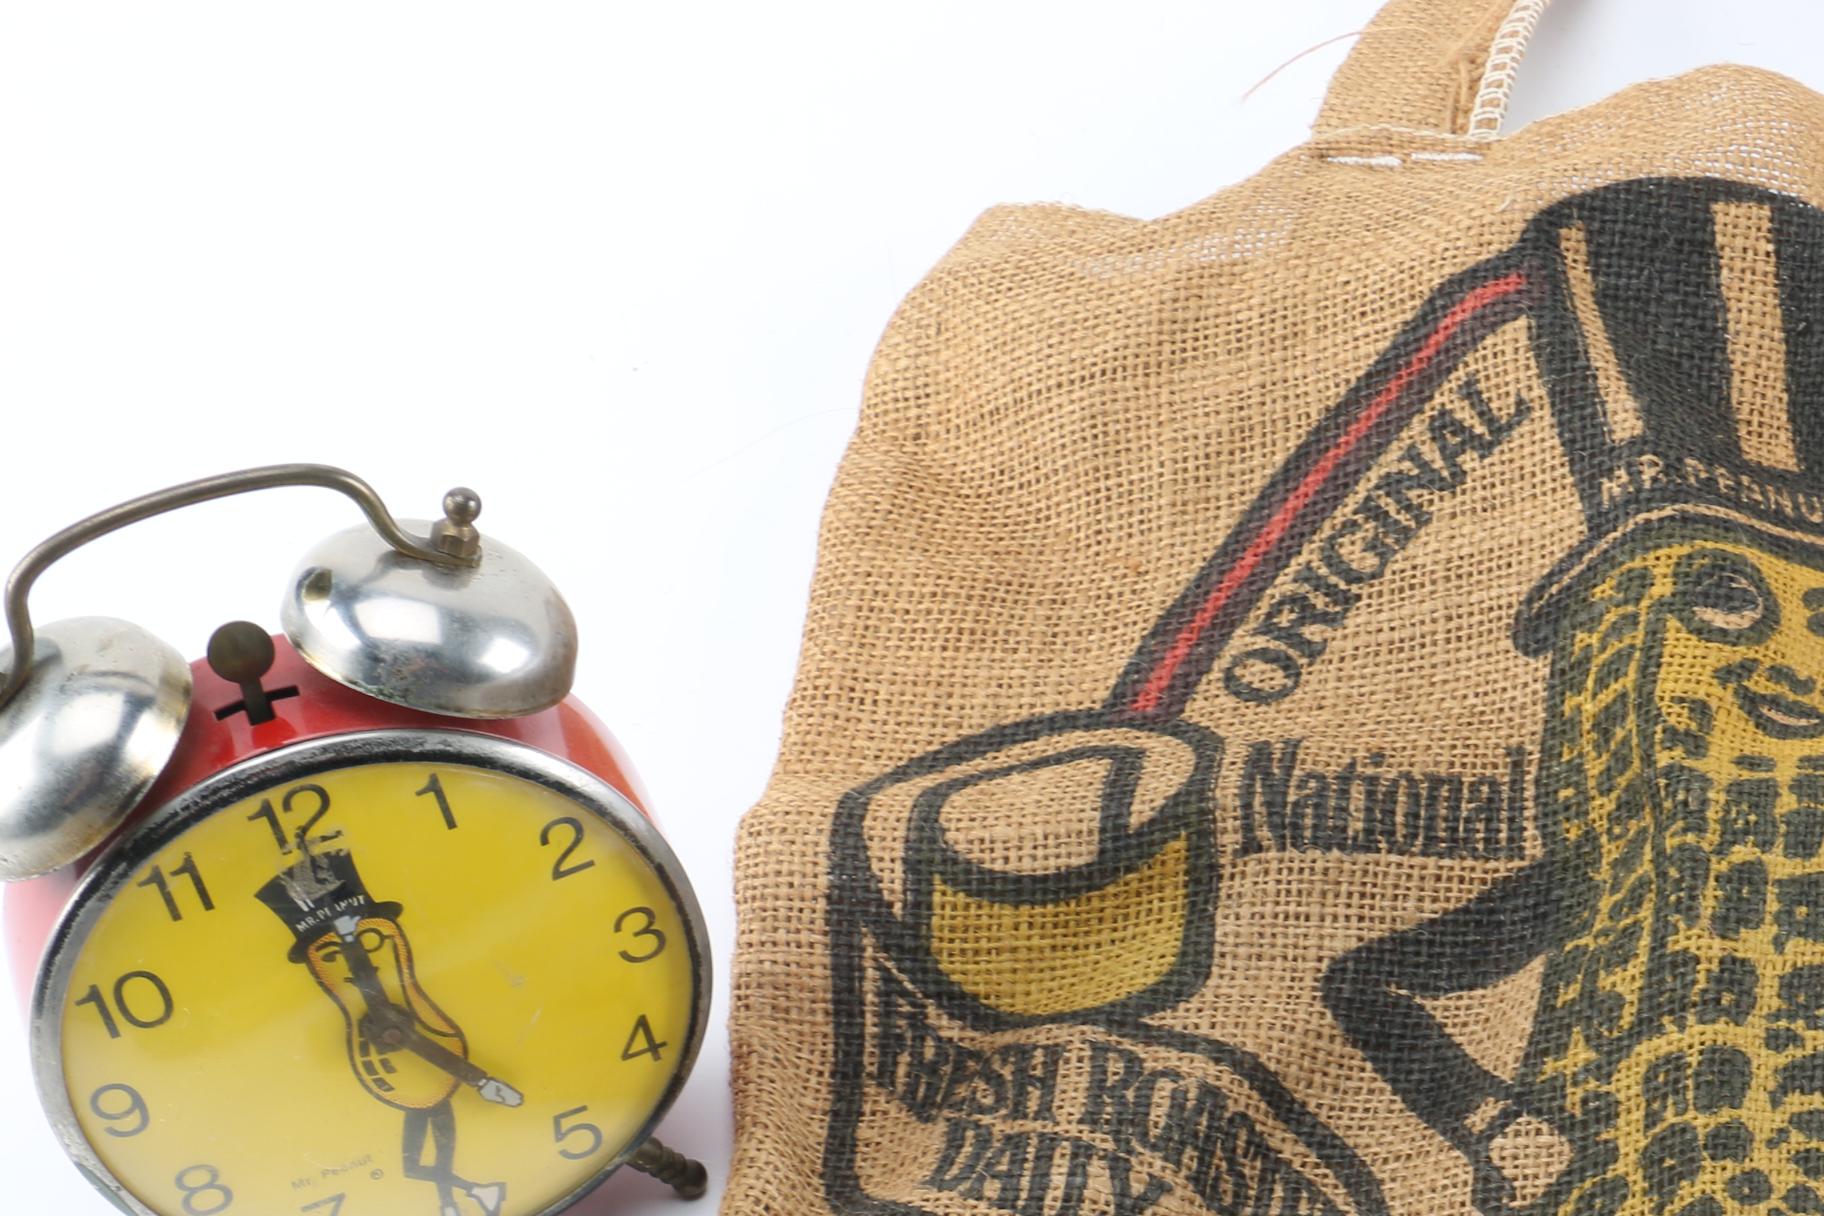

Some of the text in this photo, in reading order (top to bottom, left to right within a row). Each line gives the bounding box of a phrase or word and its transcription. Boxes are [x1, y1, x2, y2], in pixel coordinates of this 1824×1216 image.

[1223, 377, 1535, 706] ORIGINAL
[247, 784, 342, 855] 12
[415, 773, 457, 830] 1
[1233, 737, 1529, 861] National
[540, 816, 596, 880] 2
[137, 852, 216, 922] 11
[613, 905, 667, 964] 3
[75, 969, 175, 1039] 10
[619, 1013, 668, 1063] 4
[877, 962, 1063, 1124] FRESH
[89, 1083, 150, 1138] 9
[552, 1105, 603, 1161] 5
[174, 1163, 234, 1216] 8
